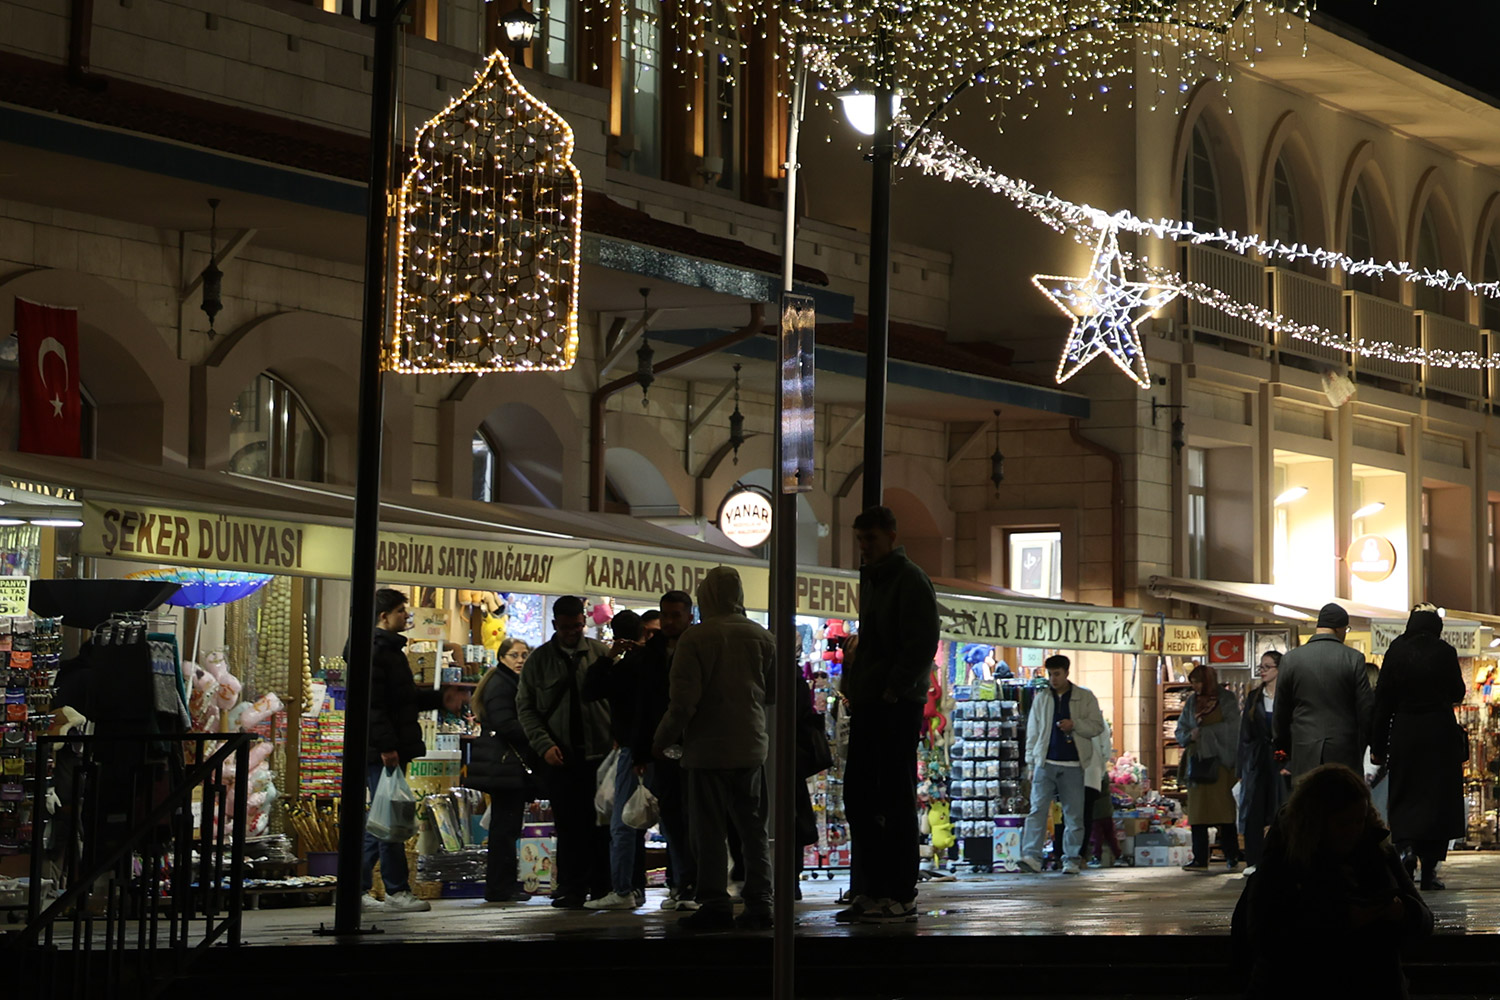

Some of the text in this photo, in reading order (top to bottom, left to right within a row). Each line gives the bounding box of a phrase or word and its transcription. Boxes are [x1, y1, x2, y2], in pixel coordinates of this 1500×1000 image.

[725, 504, 768, 524] YANAR
[102, 507, 304, 568] ŞEKER DÜNYASI
[377, 537, 554, 583] ABRİKA SATIŞ MAĞAZASI
[939, 608, 1136, 646] ANAR HEDİYELİK
[1442, 630, 1476, 649] EKERLEME
[1167, 641, 1207, 652] HEDİYELİK
